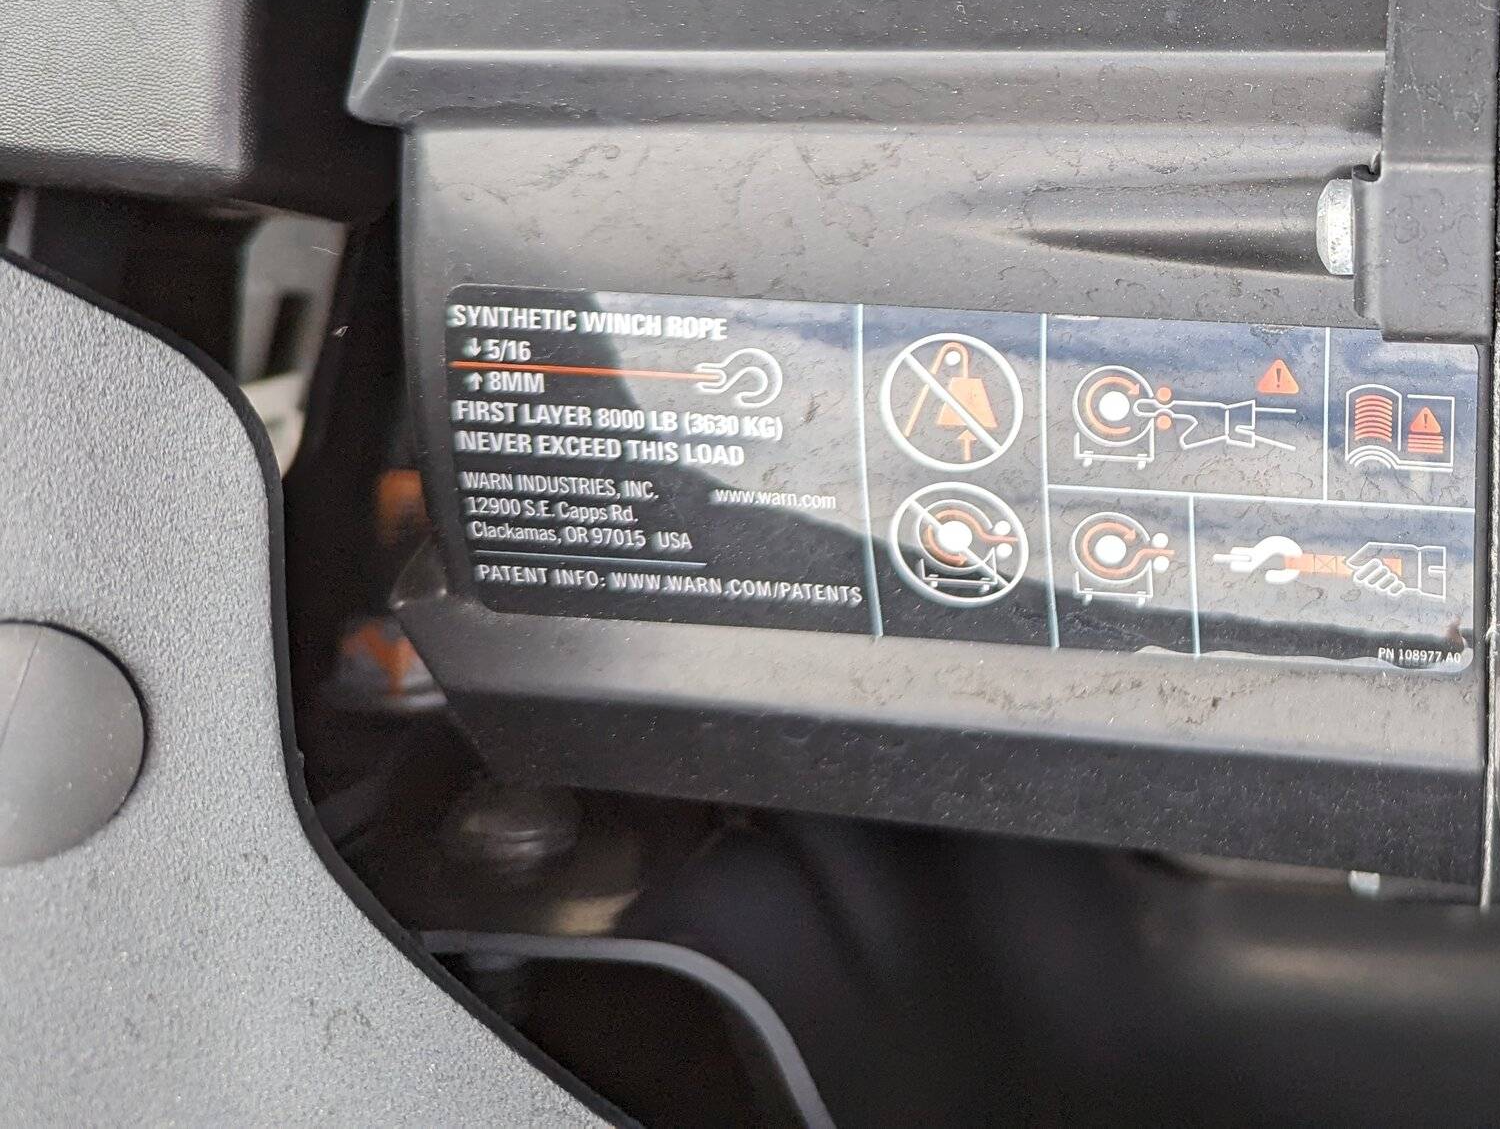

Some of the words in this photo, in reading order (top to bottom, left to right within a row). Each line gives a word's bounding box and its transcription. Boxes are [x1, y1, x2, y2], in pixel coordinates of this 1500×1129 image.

[452, 304, 577, 332] SYNTHETIC
[582, 311, 662, 336] WINCH
[666, 317, 728, 340] ROPE
[486, 339, 532, 362] 5/16
[490, 371, 546, 394] 8MM
[455, 399, 518, 424] FIRST
[522, 403, 593, 428] LAYER
[597, 407, 645, 431] 8000
[650, 410, 678, 433] LB
[683, 411, 740, 437] (3630
[743, 415, 783, 442] KG)
[456, 430, 533, 454] NEVER
[536, 435, 623, 460] EXCEED
[626, 439, 680, 463] THIS
[684, 442, 745, 467] LOAD
[463, 471, 514, 491] WARN
[517, 474, 621, 501] INDUSTRIES,
[624, 480, 660, 500] INC.
[712, 489, 837, 510] www.warn.com
[467, 497, 521, 516] 12900
[523, 499, 556, 518] S.E.
[557, 501, 608, 524] Capps
[611, 504, 639, 523] Rd.
[471, 520, 562, 545] Clackamas,
[564, 526, 590, 544] OR
[591, 528, 646, 548] 97015
[656, 531, 693, 550] USA
[478, 564, 548, 584] PATENT
[551, 568, 606, 588] INFO:
[610, 571, 863, 607] WWW.WARN.COM/PATENTS
[1378, 647, 1395, 661] PN
